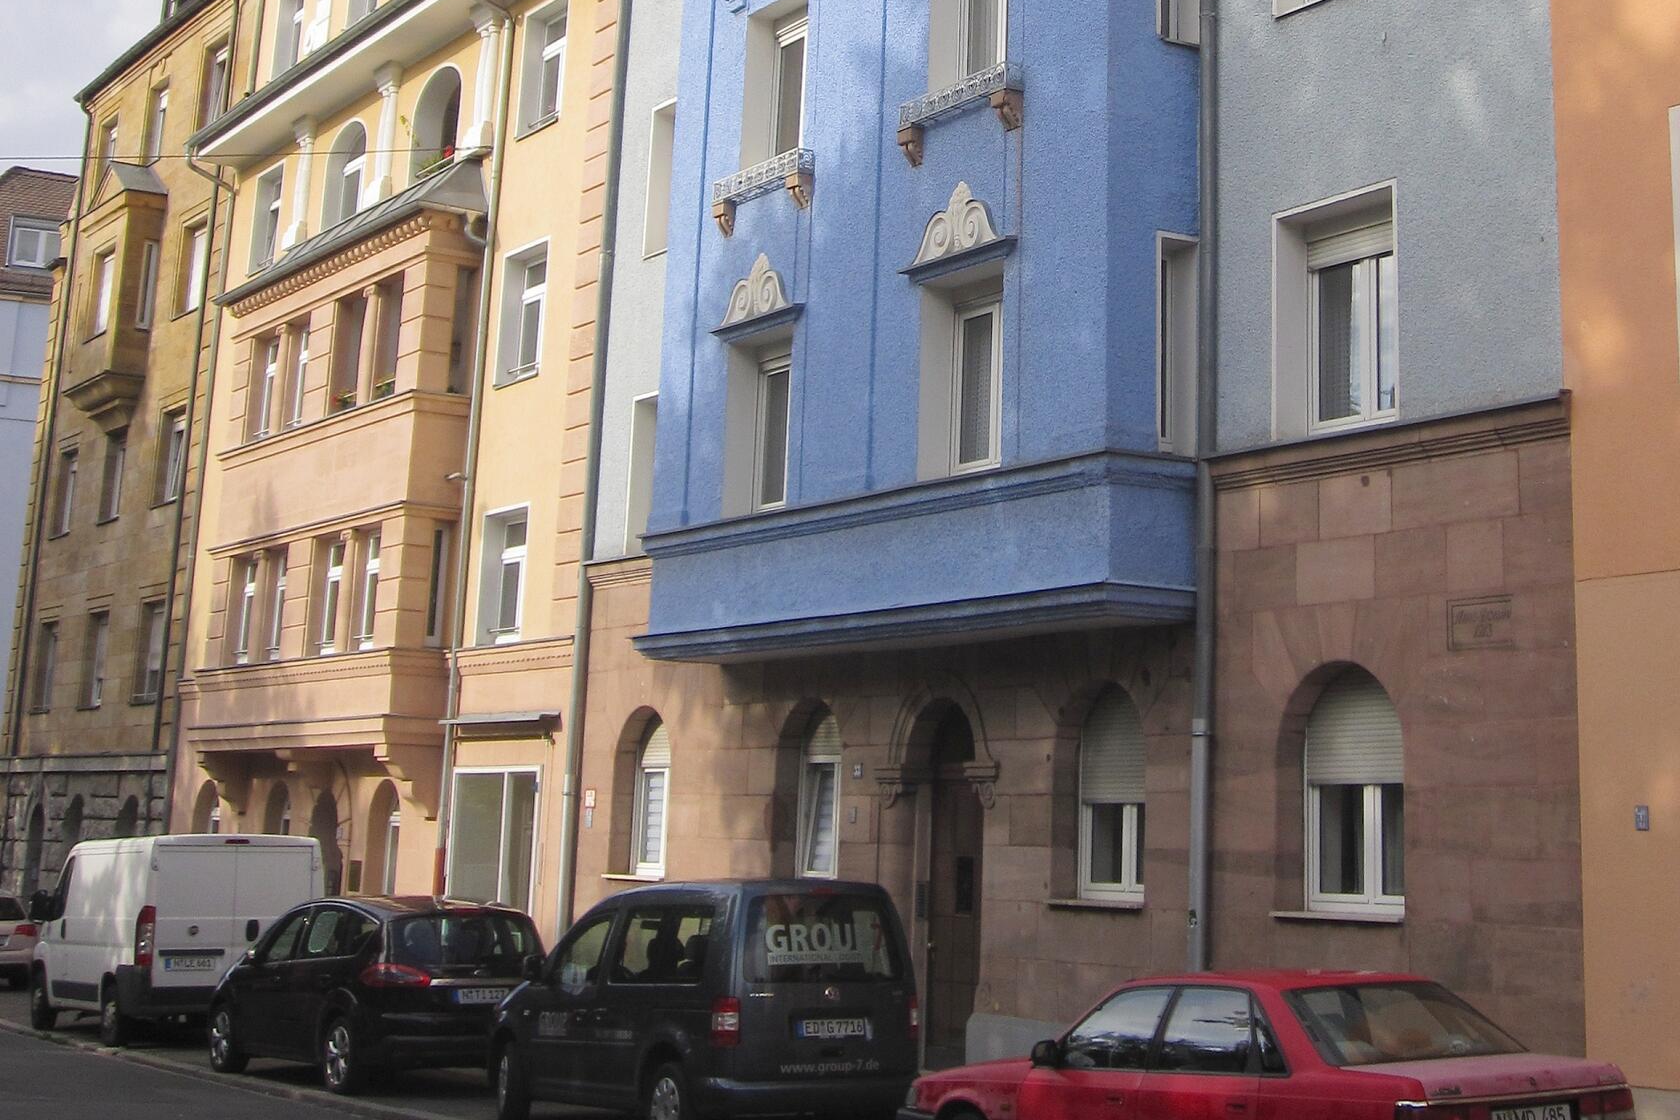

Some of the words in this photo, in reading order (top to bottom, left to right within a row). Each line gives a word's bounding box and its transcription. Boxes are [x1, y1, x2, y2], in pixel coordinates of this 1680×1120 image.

[766, 923, 865, 953] GROU
[804, 1021, 820, 1034] ED
[780, 1058, 880, 1075] www.group-7.de
